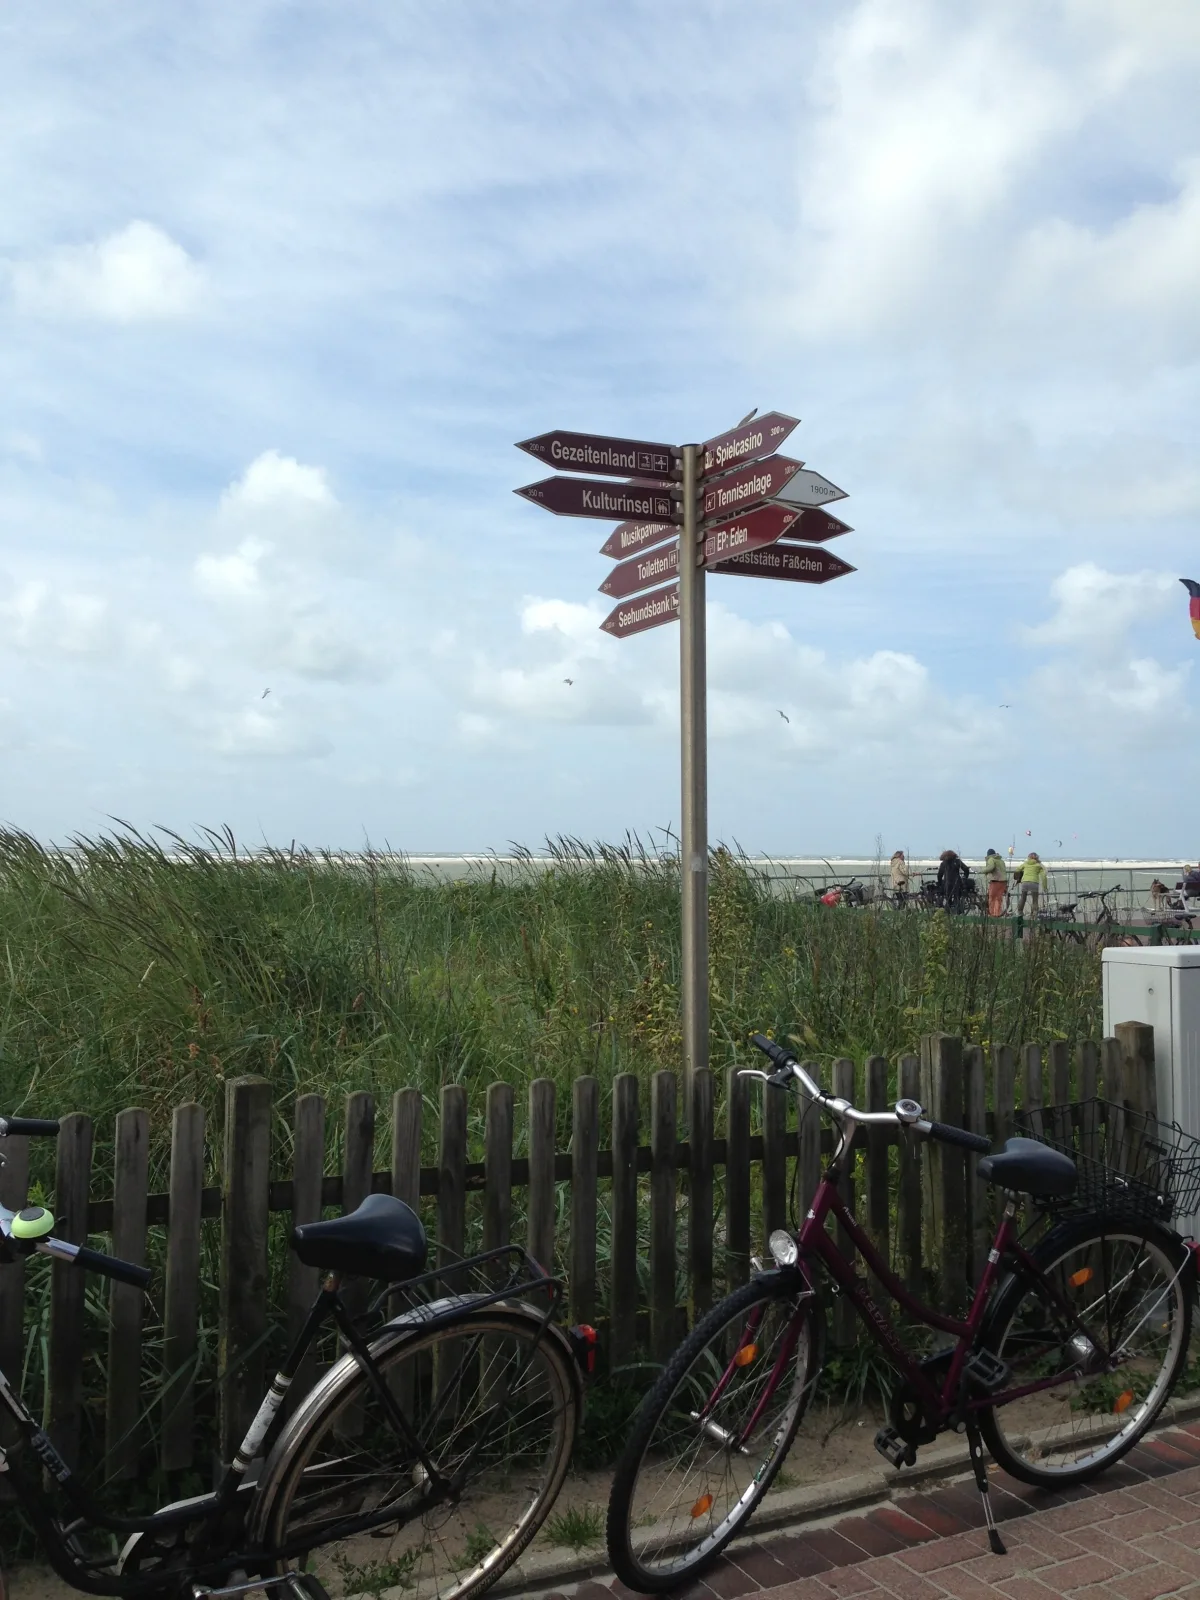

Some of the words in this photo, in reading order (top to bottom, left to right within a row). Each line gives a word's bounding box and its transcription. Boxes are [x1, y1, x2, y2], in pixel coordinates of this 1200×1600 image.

[530, 442, 540, 450] 200
[551, 440, 636, 468] Gezeitenland
[716, 432, 763, 467] Spielcasino
[770, 426, 780, 437] 300
[582, 490, 653, 515] Kulturinsel
[717, 473, 772, 507] Tennisanlage
[810, 485, 829, 495] 1900
[829, 489, 836, 497] m
[717, 532, 729, 551] EP:
[730, 526, 748, 547] Eden
[638, 557, 668, 580] Toiletten
[783, 553, 823, 571] Fäßchen
[619, 595, 669, 627] Seehundsbank
